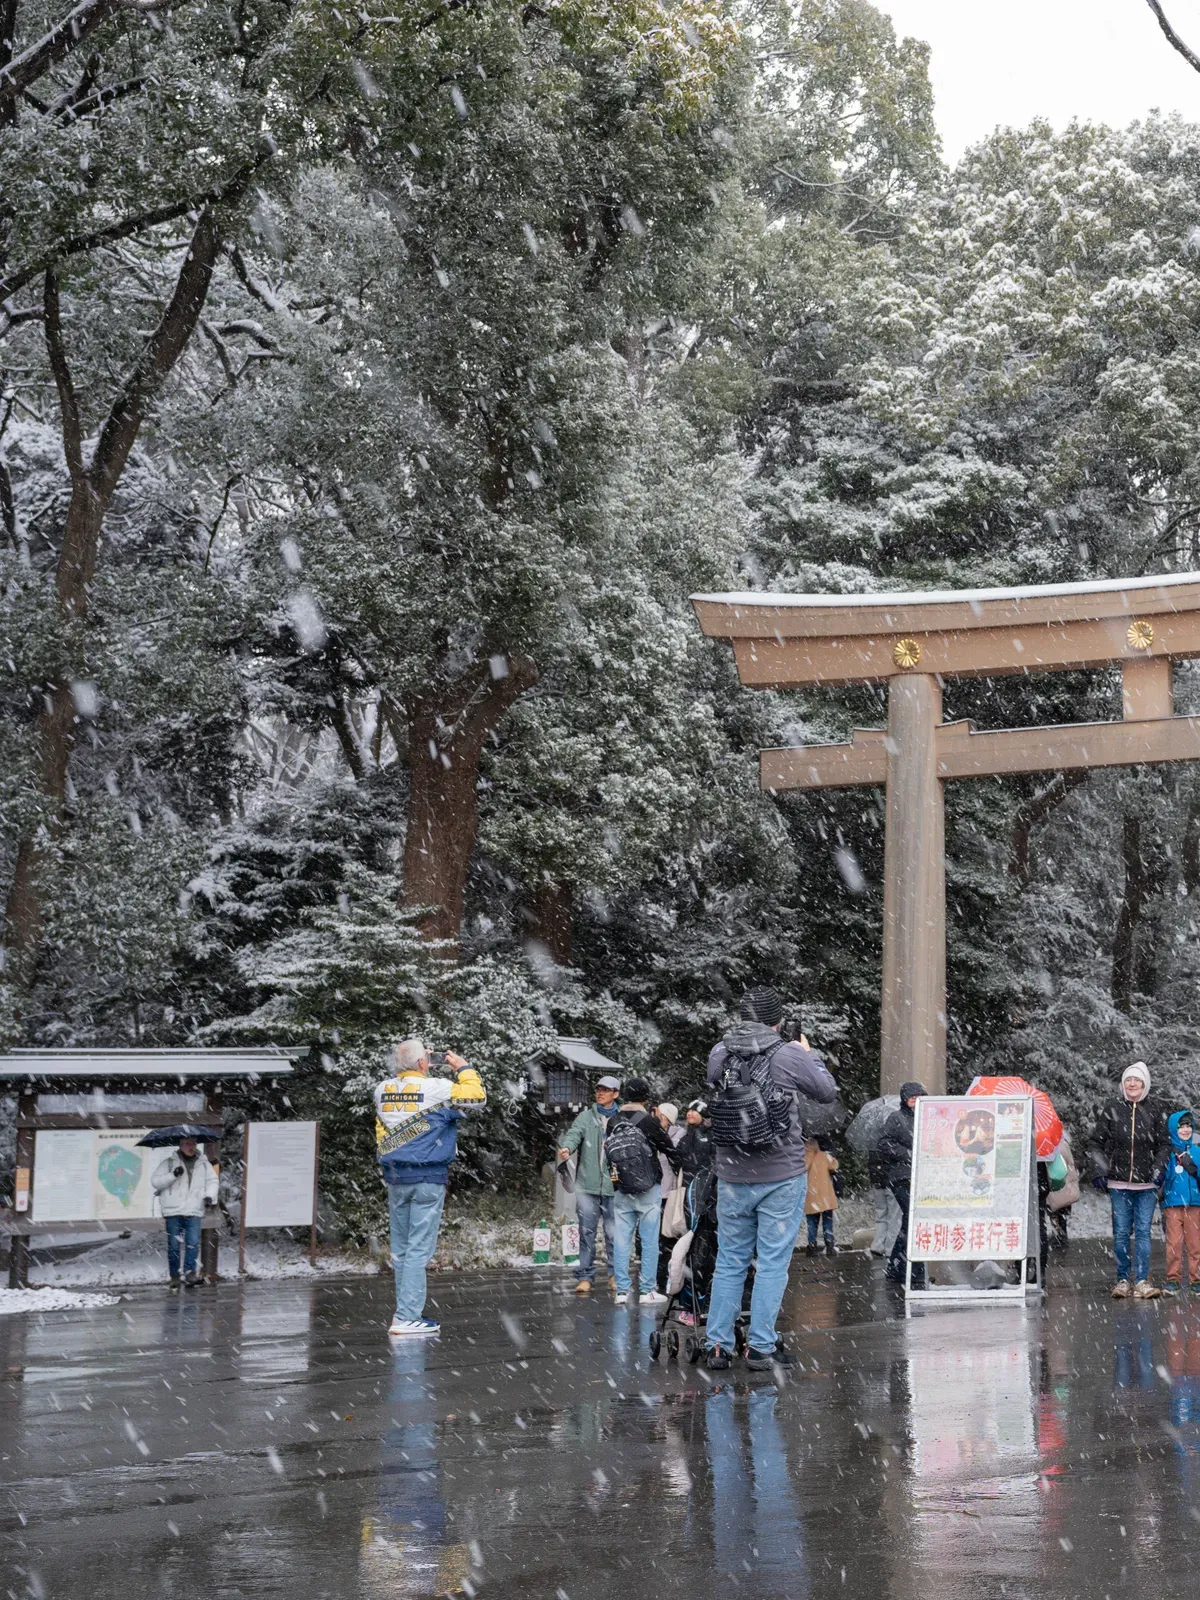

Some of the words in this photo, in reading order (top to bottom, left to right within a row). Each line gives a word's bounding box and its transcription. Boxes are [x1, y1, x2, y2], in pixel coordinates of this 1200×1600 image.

[915, 1220, 1019, 1253] 特別参拝行事
